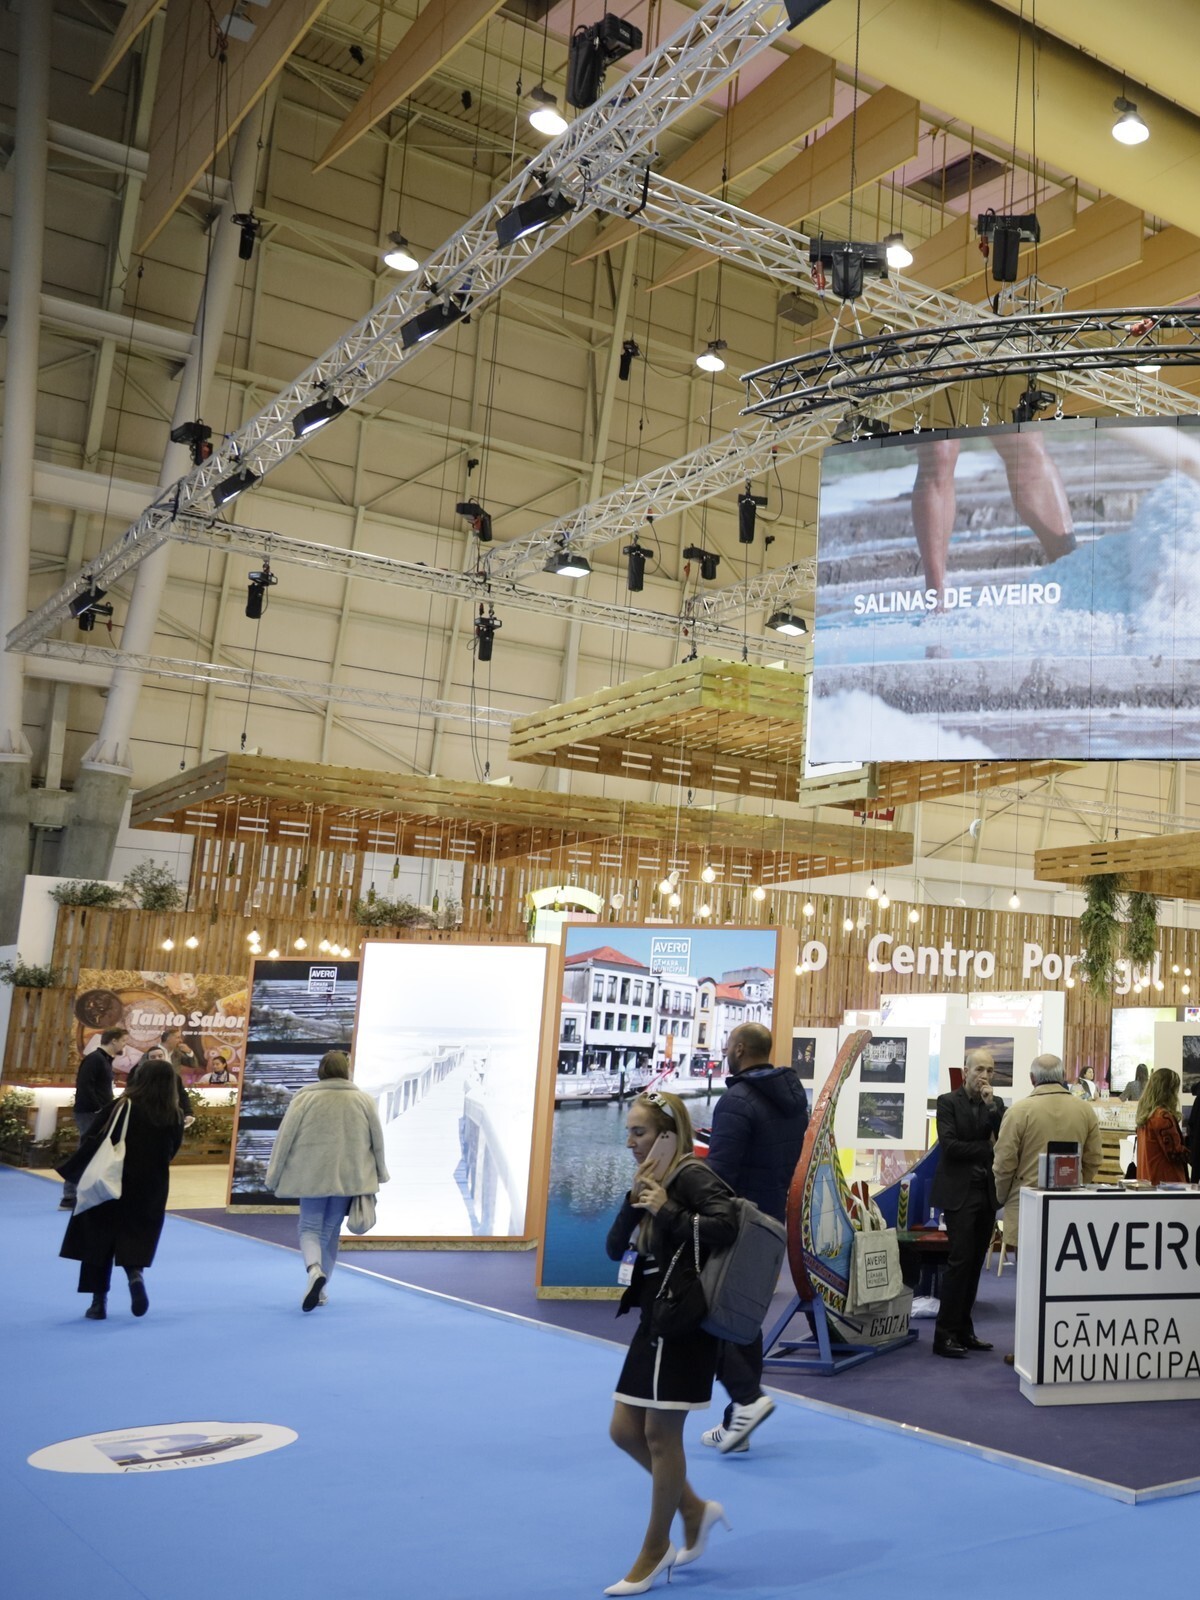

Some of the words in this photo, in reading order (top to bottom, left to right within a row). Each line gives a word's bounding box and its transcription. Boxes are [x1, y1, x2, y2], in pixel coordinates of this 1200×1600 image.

[853, 588, 938, 615] SALINAS
[943, 586, 973, 609] DE
[977, 582, 1061, 608] AVEIRO
[654, 942, 688, 953] AVEIRO
[868, 933, 995, 979] Centro
[130, 1009, 186, 1027] Tanto
[188, 1011, 246, 1028] Sabor
[124, 1455, 216, 1473] AVEIRO
